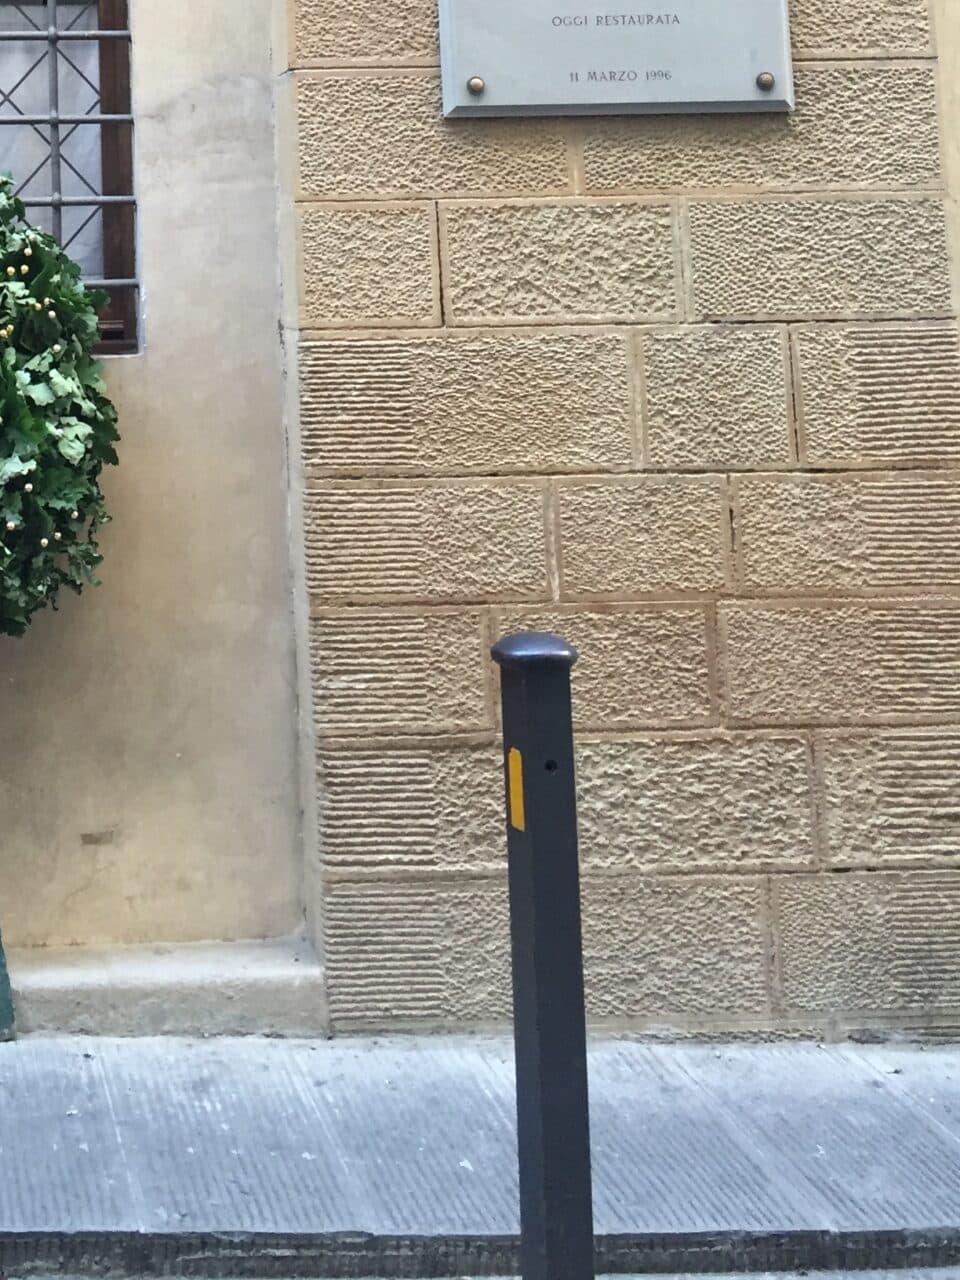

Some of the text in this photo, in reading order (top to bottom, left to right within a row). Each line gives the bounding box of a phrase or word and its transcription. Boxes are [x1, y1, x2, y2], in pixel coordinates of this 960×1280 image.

[551, 14, 681, 27] OGGI RESTAURATA
[588, 70, 639, 82] MARZO
[645, 69, 673, 81] 1996
